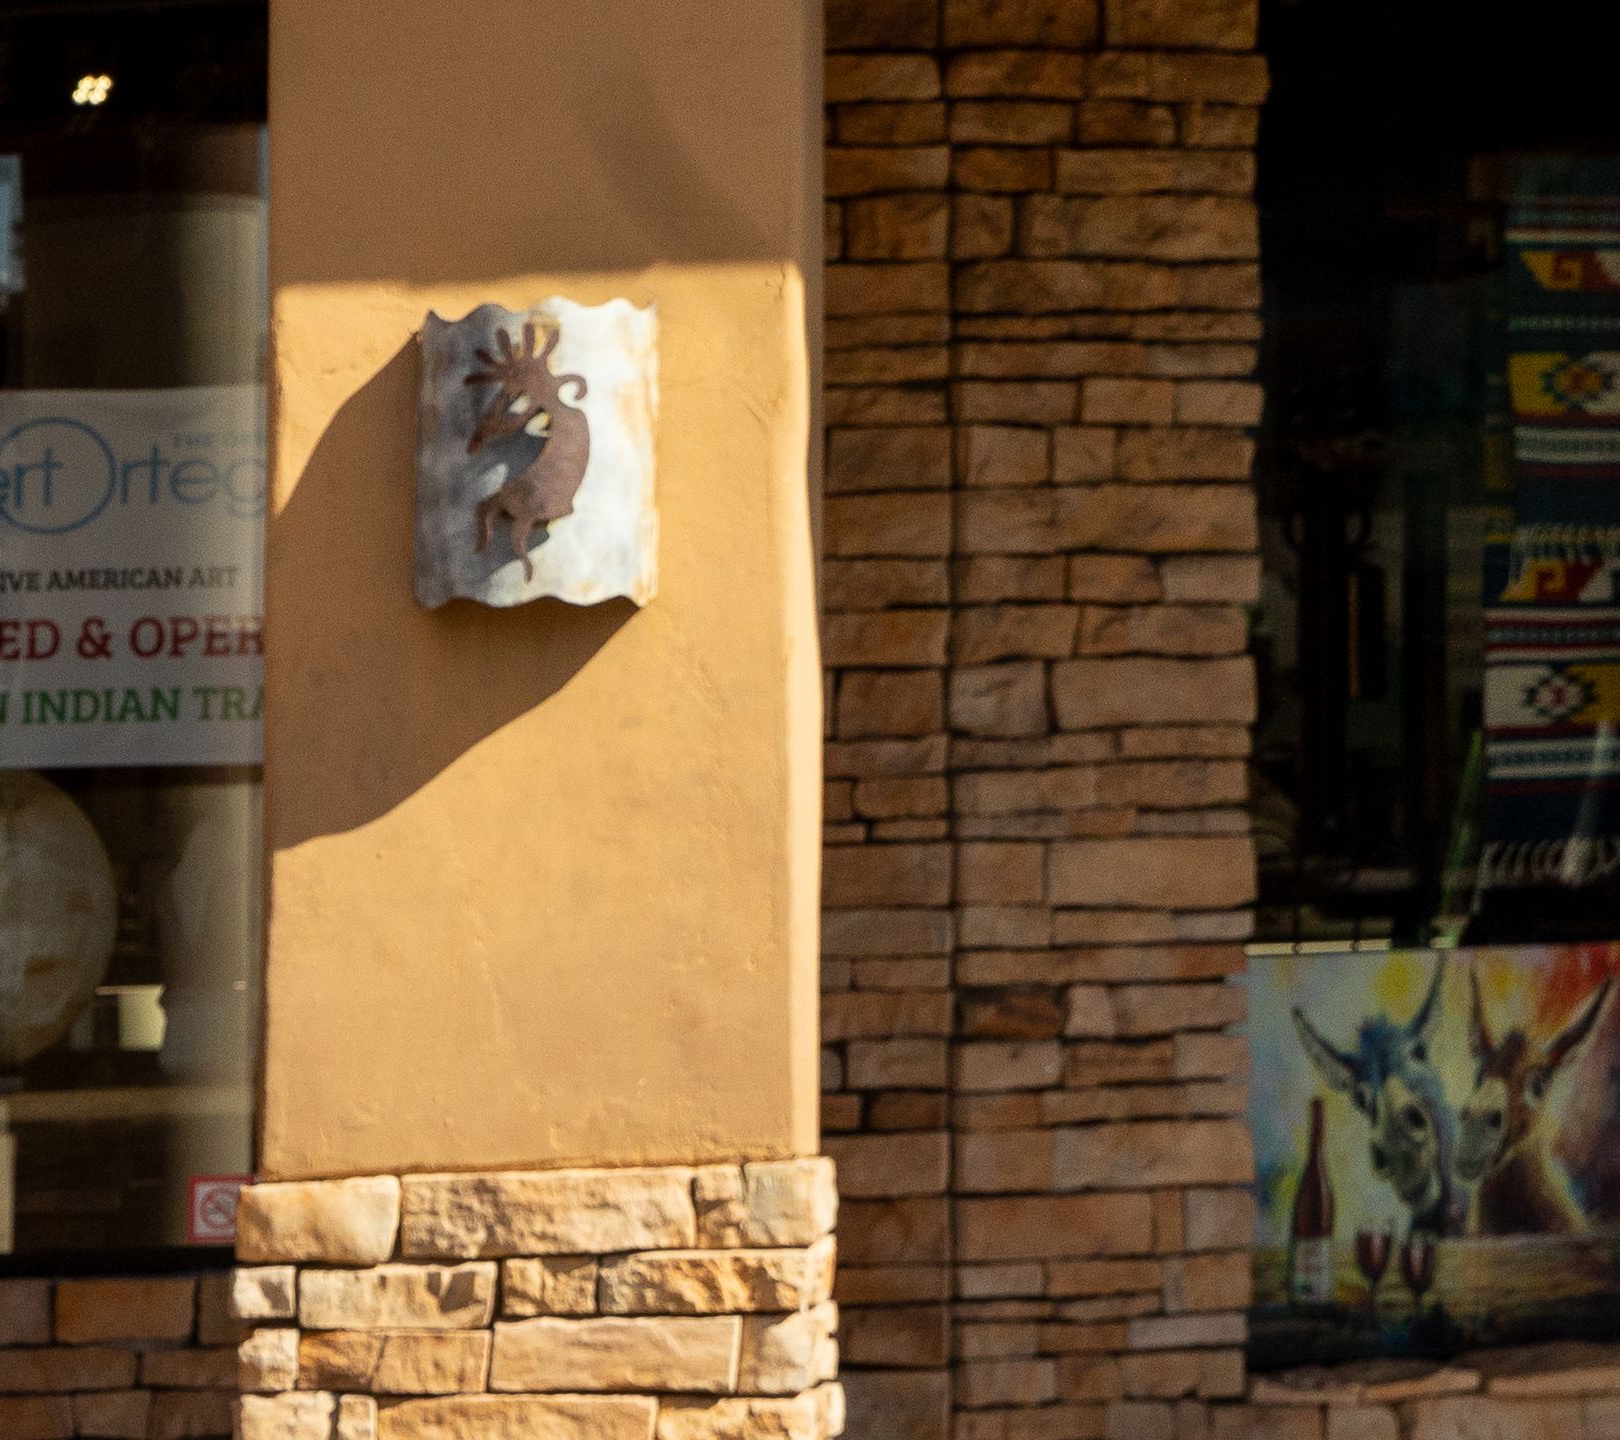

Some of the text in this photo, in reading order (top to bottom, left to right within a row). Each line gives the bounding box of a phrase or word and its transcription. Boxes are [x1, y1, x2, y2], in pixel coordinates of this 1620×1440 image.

[44, 565, 183, 594] AMERICAN
[187, 564, 240, 590] ART
[75, 614, 115, 660] &
[20, 685, 182, 727] INDIAN
